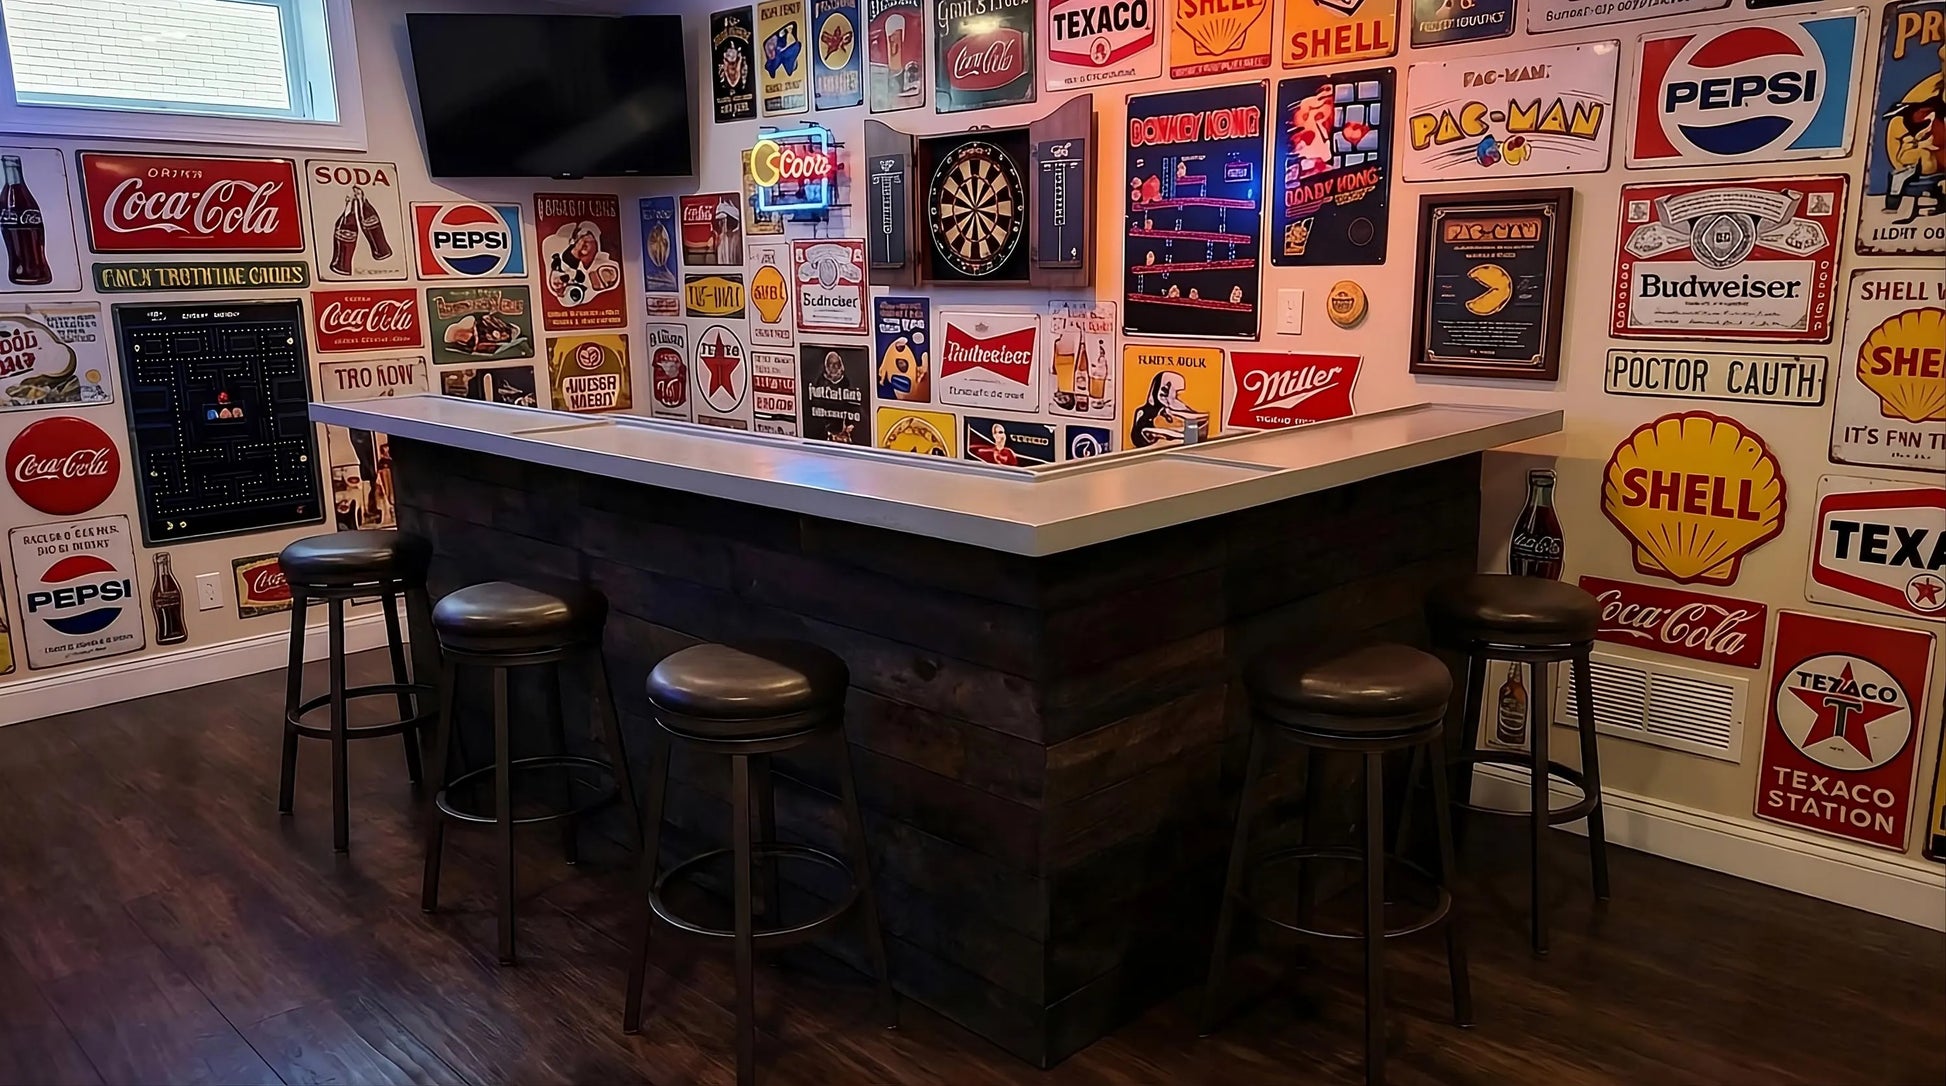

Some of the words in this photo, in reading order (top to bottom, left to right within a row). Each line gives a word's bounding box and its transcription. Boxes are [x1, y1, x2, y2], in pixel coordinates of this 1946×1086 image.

[1053, 1, 1148, 41] TEXACO
[1290, 20, 1389, 60] SHELL
[1665, 69, 1818, 113] PEPSI
[1409, 97, 1604, 151] PAC-MAN
[314, 166, 391, 187] SODA
[103, 177, 284, 235] Coca-Cola
[433, 230, 508, 250] PEPSI
[1861, 281, 1929, 301] SHELL
[1243, 364, 1344, 406] Miller
[1613, 356, 1709, 392] POCTOR
[1727, 360, 1818, 398] CAUTH
[1844, 425, 1880, 446] IT'S
[1621, 467, 1761, 522] SHELL
[27, 579, 132, 613] PEPSI
[1772, 766, 1895, 809] TEXACO
[1767, 789, 1894, 835] STATION
